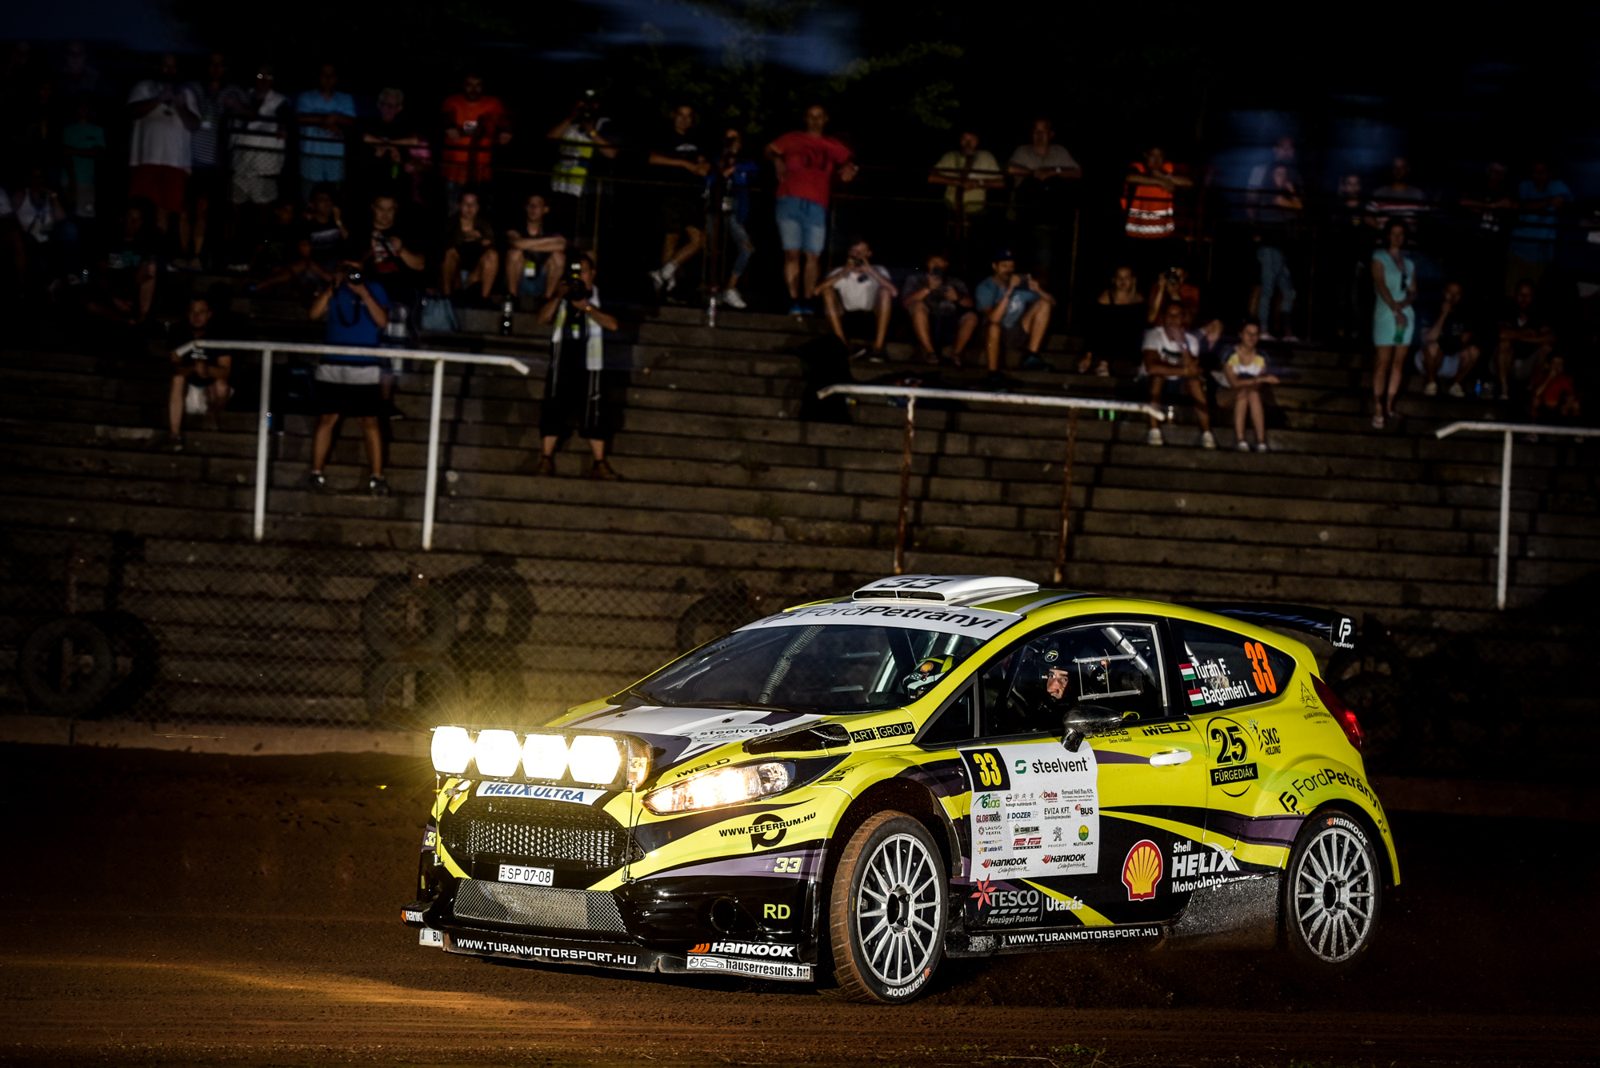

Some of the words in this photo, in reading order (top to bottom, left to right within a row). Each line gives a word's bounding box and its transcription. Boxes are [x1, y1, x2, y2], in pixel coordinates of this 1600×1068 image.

[1244, 641, 1277, 694] 33
[1201, 681, 1247, 706] Bagaméri
[1244, 680, 1257, 697] L.
[853, 729, 873, 742] ART
[879, 723, 913, 737] GROUP
[1262, 728, 1280, 745] SKC
[1210, 726, 1247, 767] 25
[972, 752, 1002, 787] 33
[1032, 757, 1089, 774] steelvent
[484, 784, 532, 796] HELIX
[533, 787, 585, 802] ULTRA
[719, 812, 816, 837] WWW.FEFERRUM.HU
[1173, 841, 1192, 853] Shell
[773, 857, 803, 873] 33
[1171, 848, 1240, 878] HELIX
[507, 868, 522, 880] SP
[523, 869, 552, 884] 07-08
[989, 889, 1039, 907] TESCO
[1046, 896, 1083, 911] Utazás
[763, 903, 791, 920] RD
[986, 916, 1015, 925] Pénzügyi
[1015, 915, 1038, 923] Partner
[1008, 927, 1159, 944] WWW.TURANMOTORSPORT.HU
[456, 938, 637, 965] WWW.TURANMOTORSPORT.HU
[725, 959, 809, 978] hauserresults.hu
